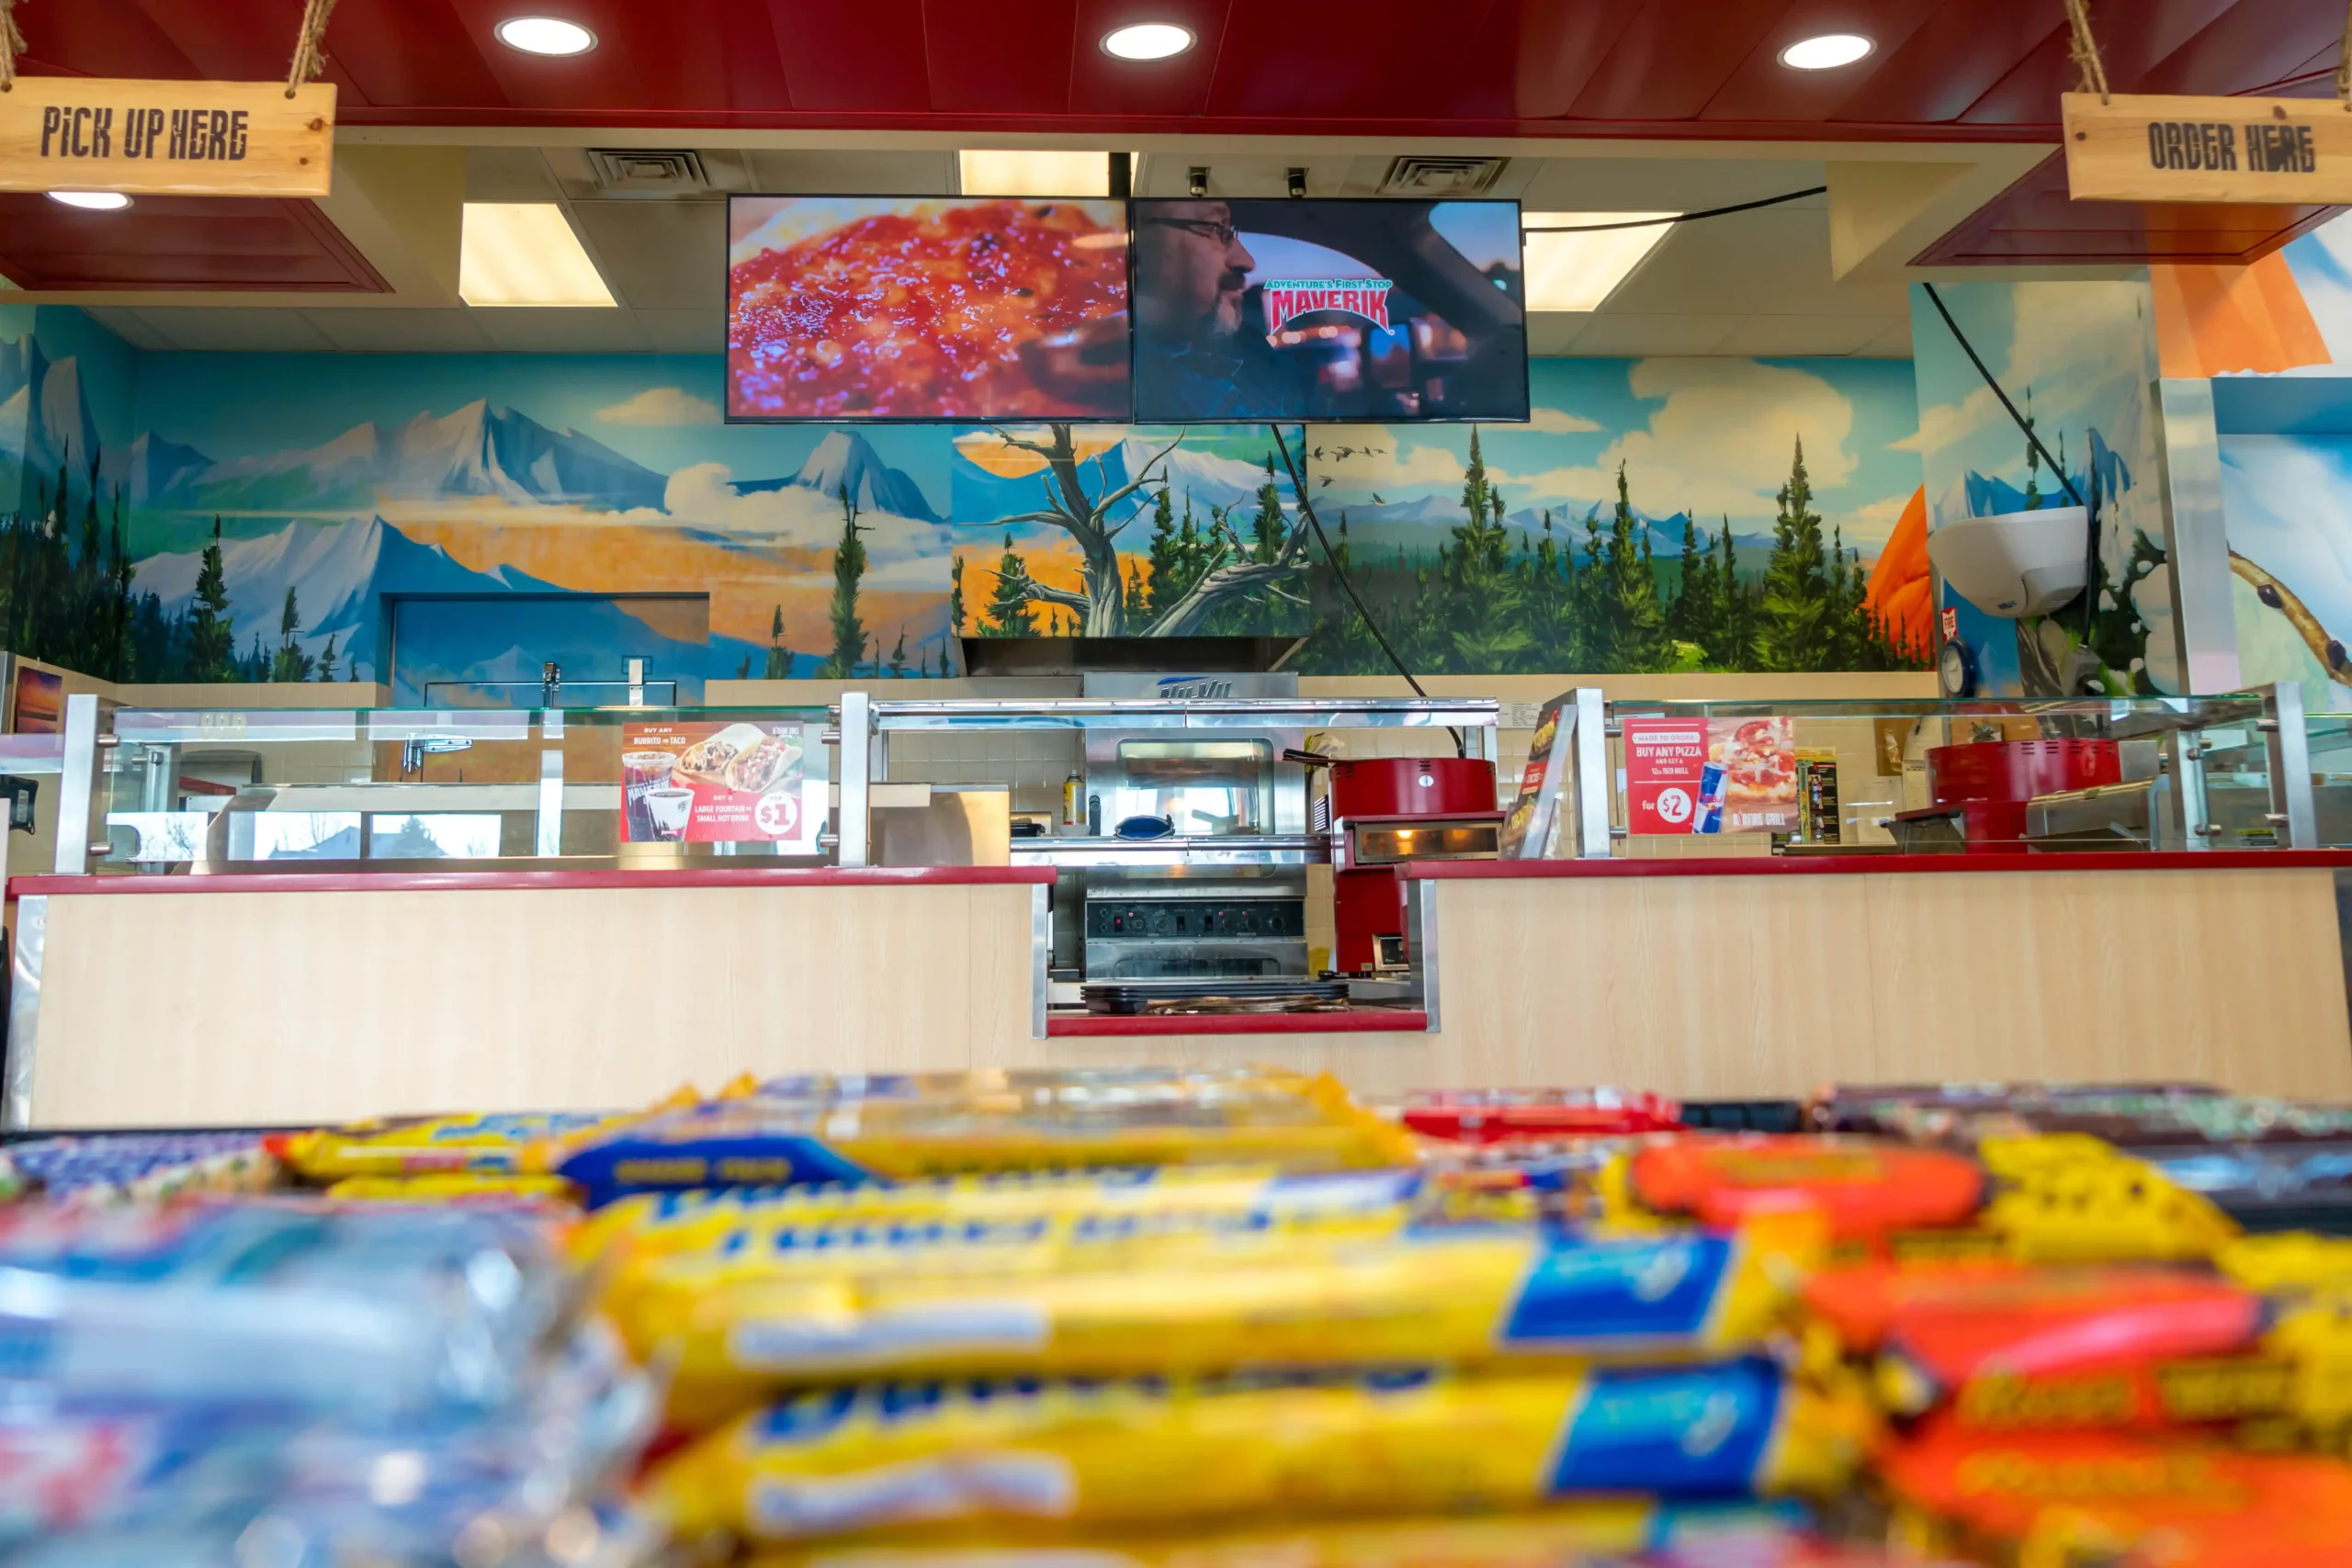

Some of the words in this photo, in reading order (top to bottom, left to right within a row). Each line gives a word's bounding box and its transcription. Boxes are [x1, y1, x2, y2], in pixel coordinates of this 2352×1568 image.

[124, 108, 164, 159] UP
[168, 109, 249, 161] HERE
[2148, 121, 2238, 172] ORDER
[2245, 124, 2316, 173] HERE
[1335, 278, 1363, 289] FIRST
[1364, 278, 1393, 289] STOP
[1270, 289, 1390, 335] MAVERIK
[634, 737, 661, 745] BURRITO
[670, 737, 686, 745] TACO
[1636, 747, 1654, 757] BUY
[1656, 747, 1674, 757] ANY
[1675, 746, 1702, 757] PIZZA
[1642, 800, 1655, 810] for
[1663, 795, 1682, 817] $2
[696, 814, 716, 822] SMALL
[718, 814, 730, 822] HOT
[760, 803, 790, 826] $1
